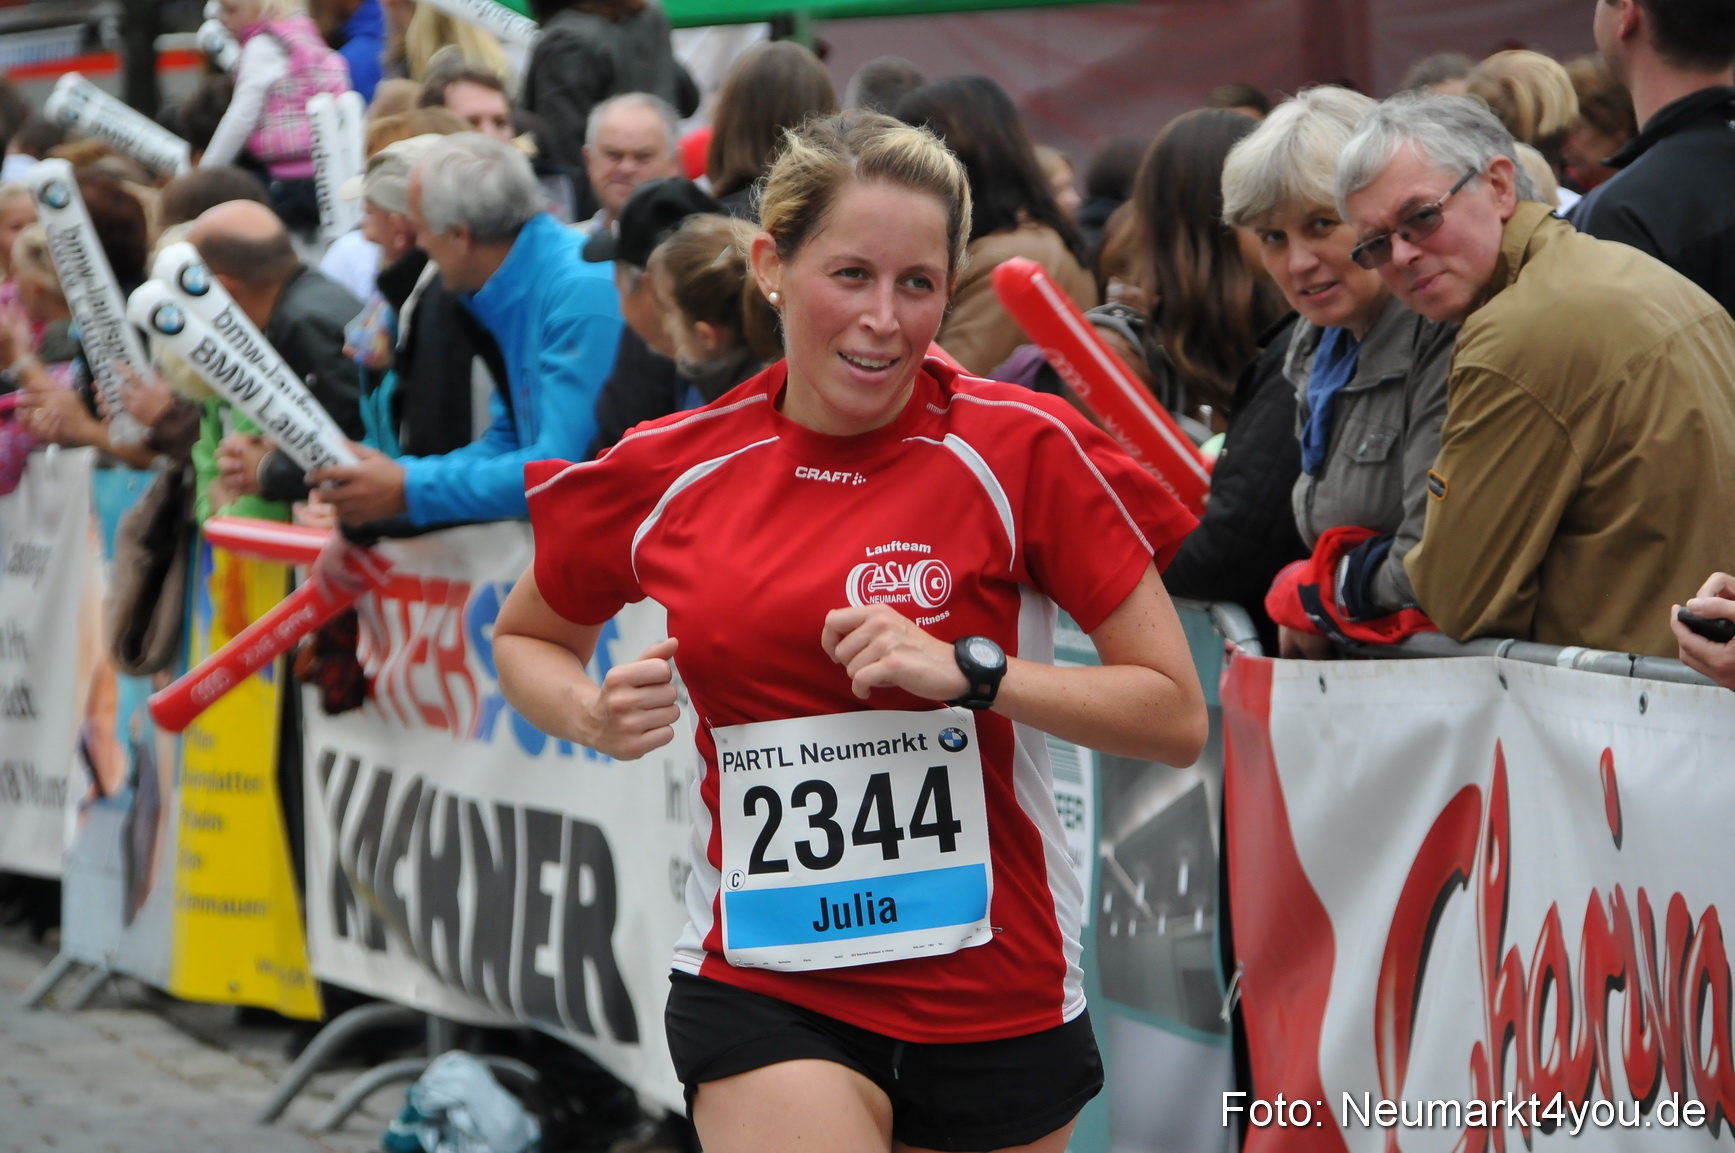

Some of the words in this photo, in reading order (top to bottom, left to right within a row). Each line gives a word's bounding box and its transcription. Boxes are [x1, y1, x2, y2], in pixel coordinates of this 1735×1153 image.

[188, 334, 263, 402] BMW
[795, 466, 852, 484] CRAFT
[865, 540, 932, 557] Laufteam
[871, 561, 912, 591] ASV
[869, 593, 912, 604] NEUMARKT
[915, 609, 951, 627] Fitness
[722, 747, 794, 773] PARTL
[799, 732, 929, 765] Neumarkt
[743, 765, 962, 876] 2344
[812, 891, 898, 933] Julia
